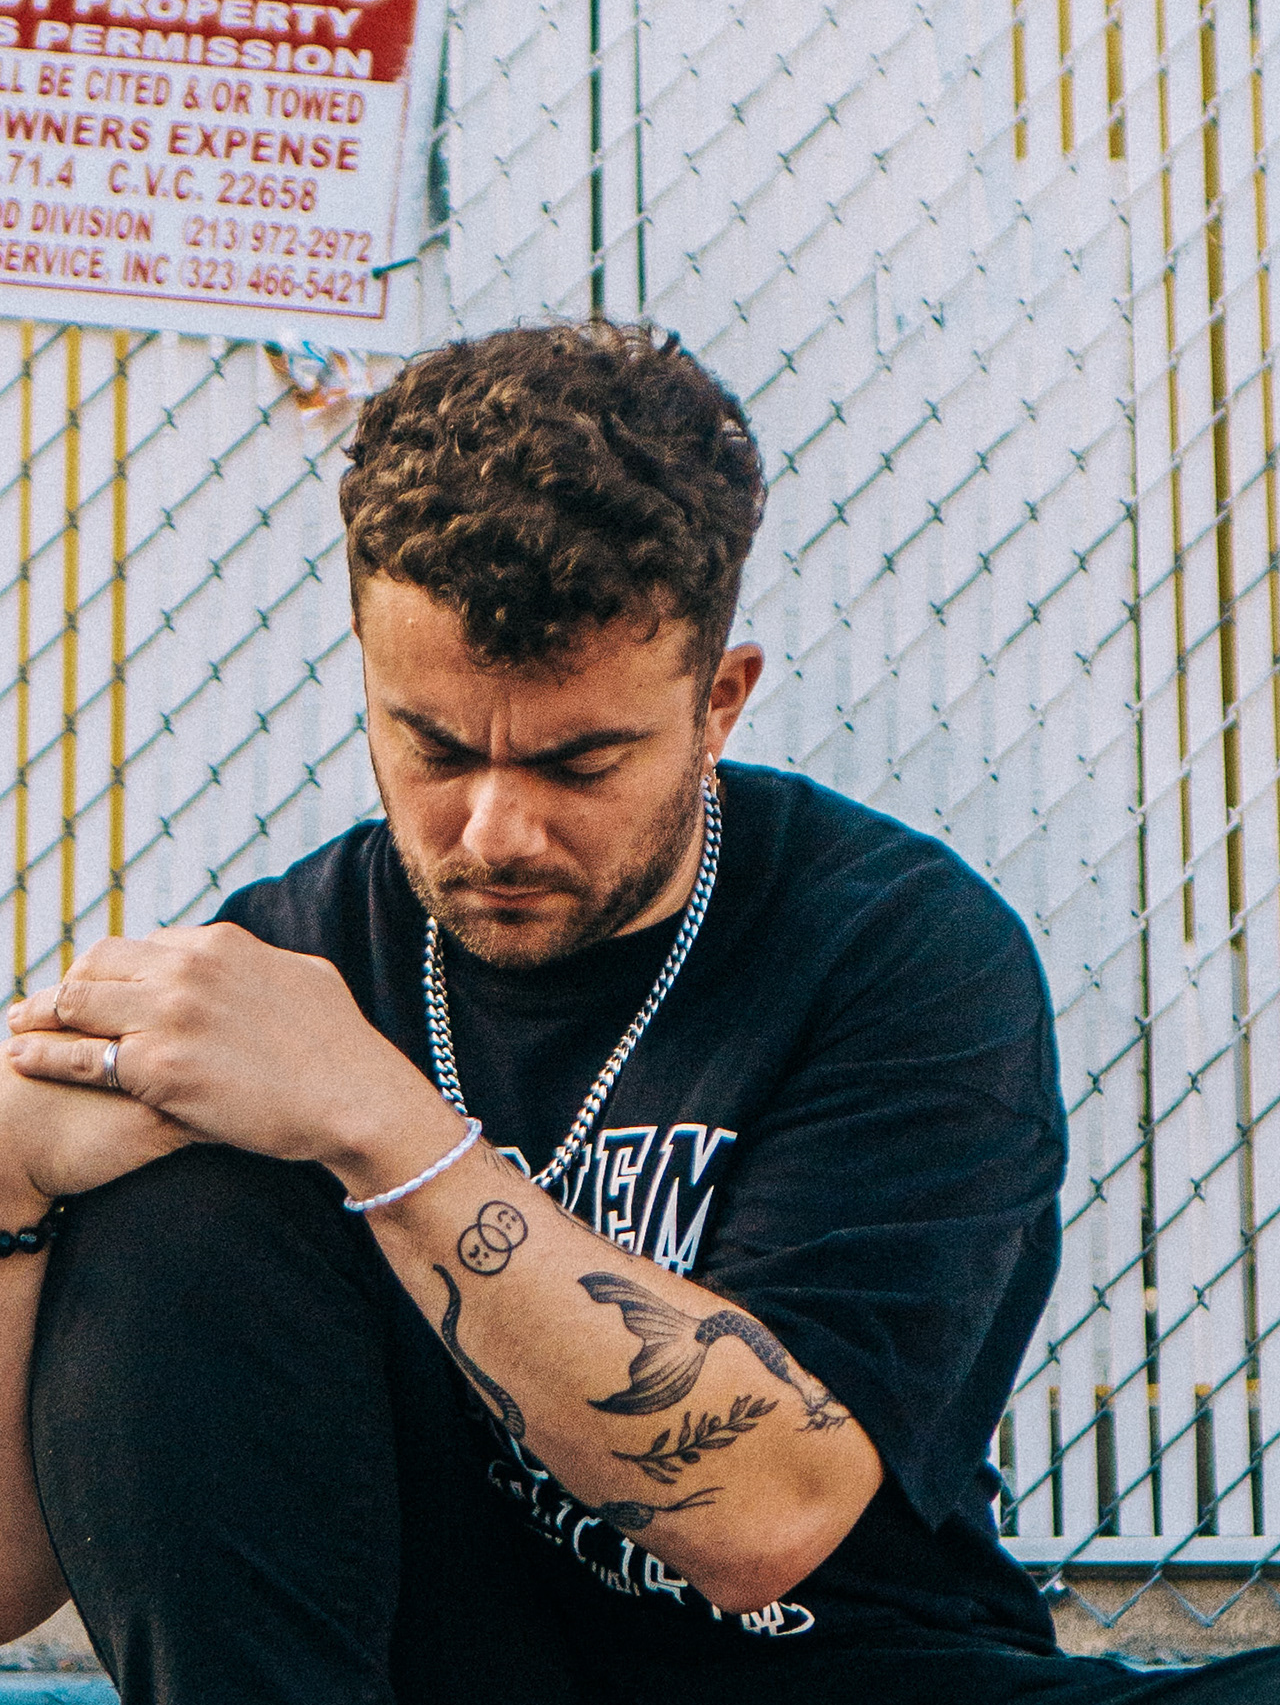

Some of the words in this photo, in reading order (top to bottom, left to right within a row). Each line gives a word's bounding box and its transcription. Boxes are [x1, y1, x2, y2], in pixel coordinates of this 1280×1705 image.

[34, 21, 371, 79] PERMISSION
[35, 64, 73, 100] BE
[84, 68, 170, 109] CITED
[181, 78, 202, 112] &
[210, 81, 252, 115] OR
[263, 84, 364, 127] TOWED
[166, 123, 358, 173] EXPENSE
[215, 172, 316, 214] 22658
[29, 202, 152, 242] DIVISION
[250, 223, 371, 265] 972-2972
[121, 255, 168, 287] INC
[245, 265, 366, 305] 466-5421
